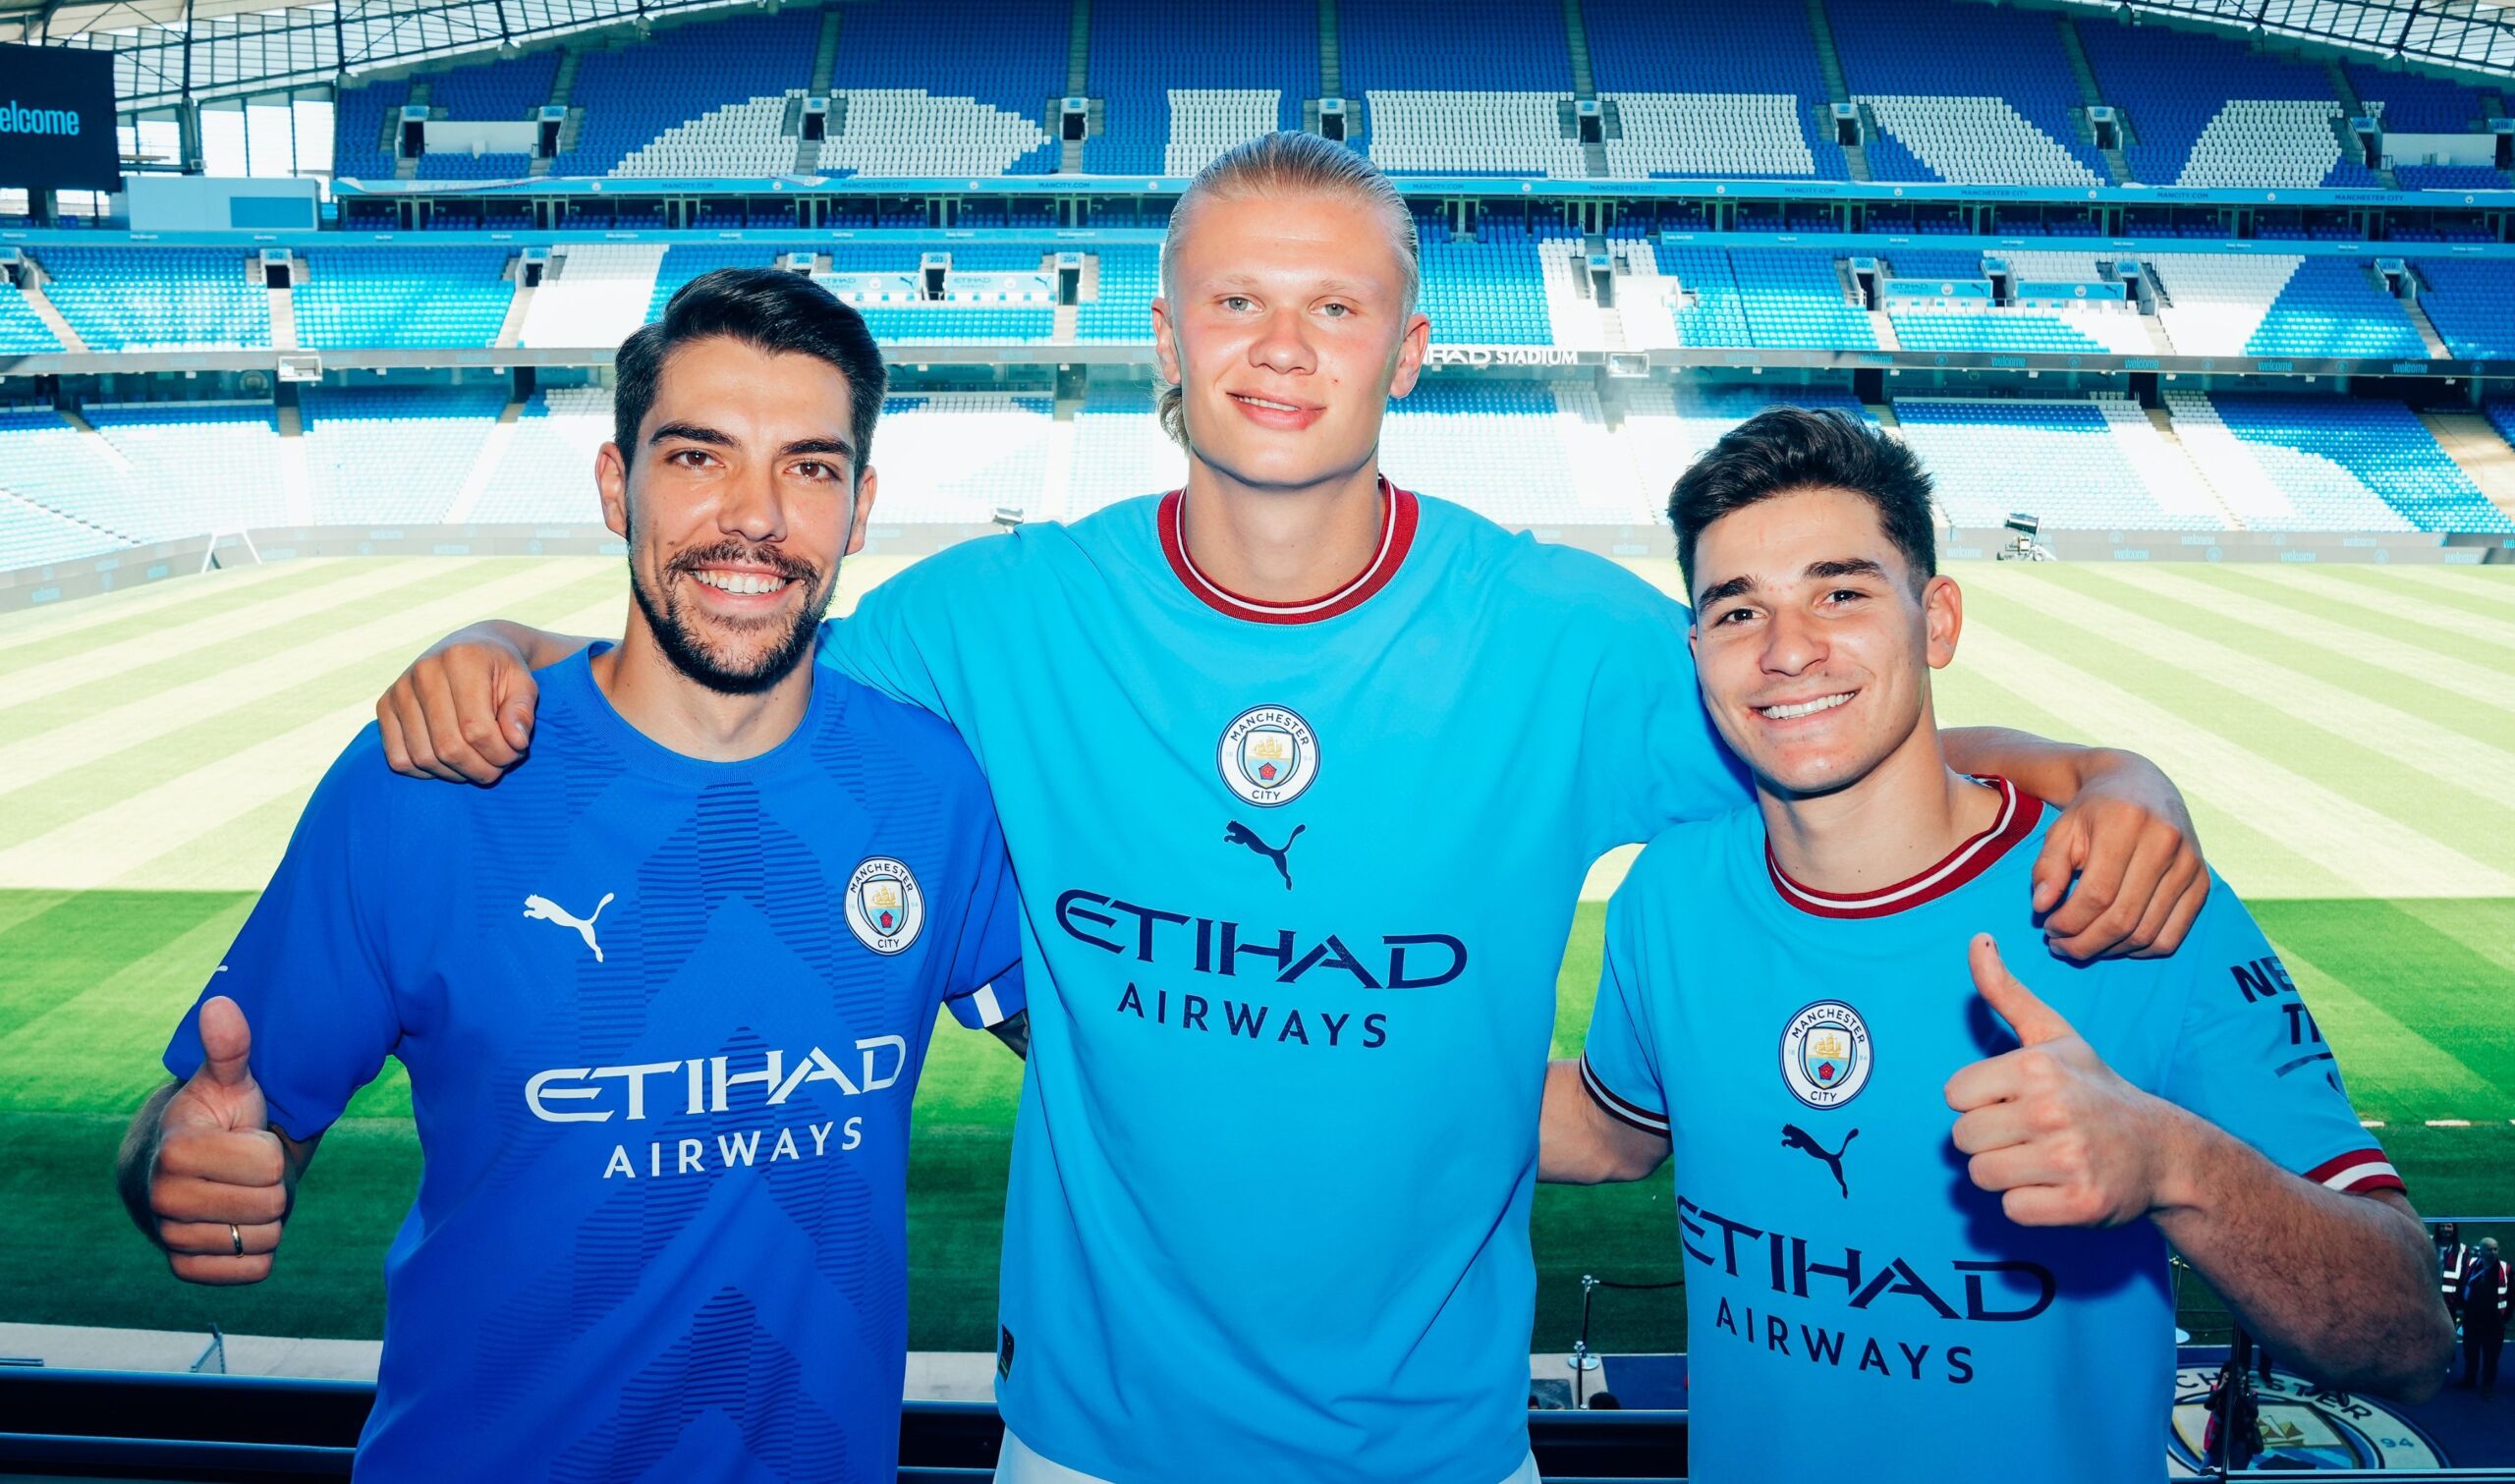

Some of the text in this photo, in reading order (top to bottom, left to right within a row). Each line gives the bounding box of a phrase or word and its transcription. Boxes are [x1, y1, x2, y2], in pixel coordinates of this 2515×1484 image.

[1961, 189, 2010, 197] MANCHESTER
[1495, 349, 1579, 365] STADIUM
[1858, 352, 1894, 366] welcome
[1990, 355, 2026, 368] welcome
[2124, 357, 2159, 370] welcome
[2258, 358, 2293, 372] welcome
[2392, 360, 2429, 374] welcome
[1230, 712, 1310, 746] MANCHESTER
[1252, 790, 1281, 800] CITY
[850, 862, 914, 894] MANCHESTER
[877, 939, 900, 949] CITY
[1055, 888, 1468, 990] ETIHAD
[1117, 981, 1388, 1049] AIRWAYS
[1791, 1008, 1866, 1044] MANCHESTER
[524, 1033, 907, 1124] ETIHAD
[1810, 1090, 1837, 1103] CITY
[602, 1116, 864, 1180] AIRWAYS
[1676, 1194, 2057, 1323] ETIHAD
[1715, 1295, 1975, 1385] AIRWAYS
[2379, 1437, 2415, 1449] 94
